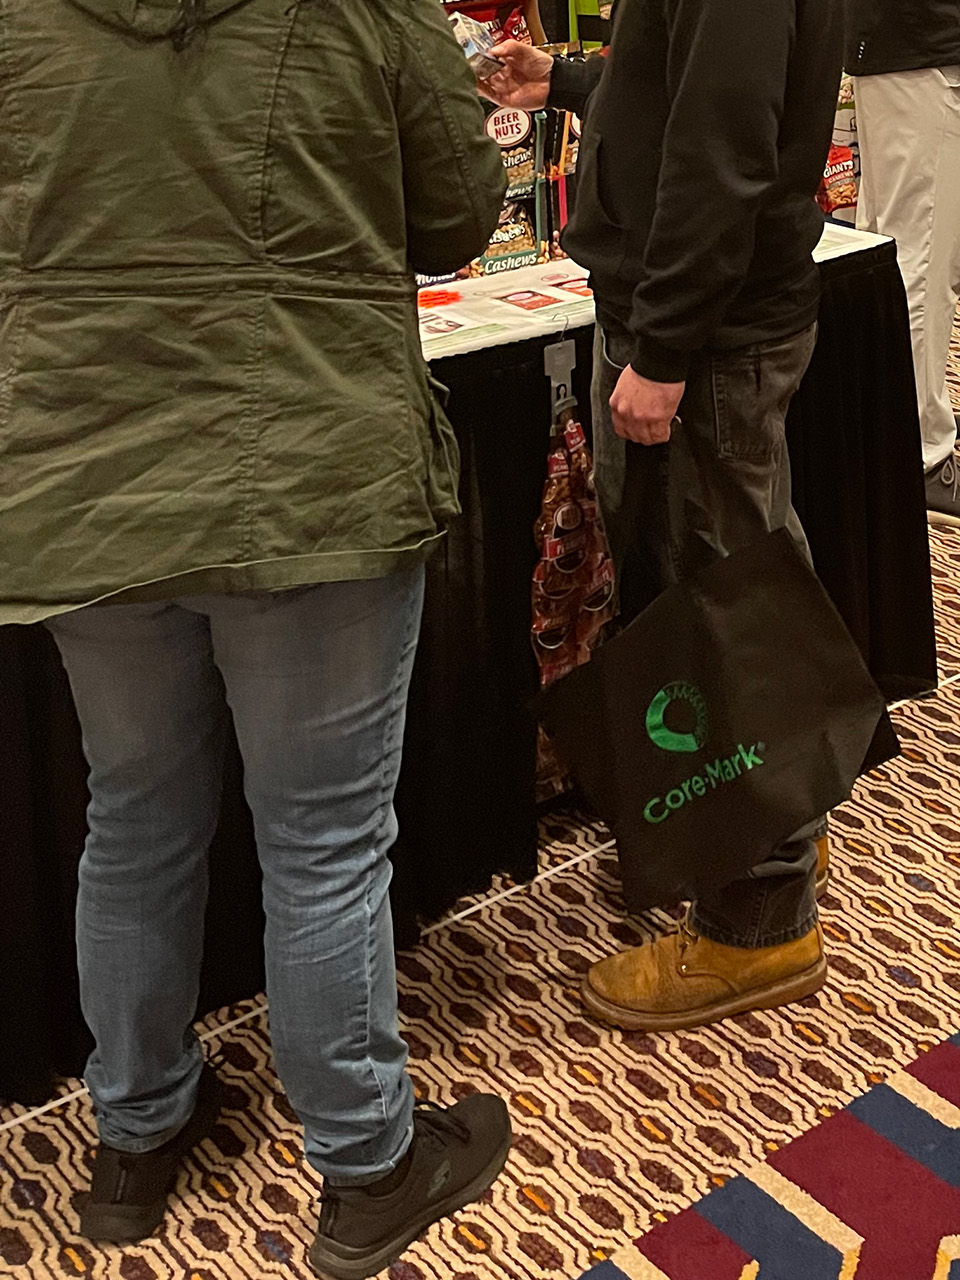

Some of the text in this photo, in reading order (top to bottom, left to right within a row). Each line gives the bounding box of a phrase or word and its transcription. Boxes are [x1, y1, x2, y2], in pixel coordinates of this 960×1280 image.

[493, 111, 519, 127] BEER
[494, 122, 522, 140] NUTS
[502, 150, 532, 168] shews
[823, 160, 854, 179] GIANTS
[506, 184, 533, 199] hews
[485, 252, 538, 275] Cashews
